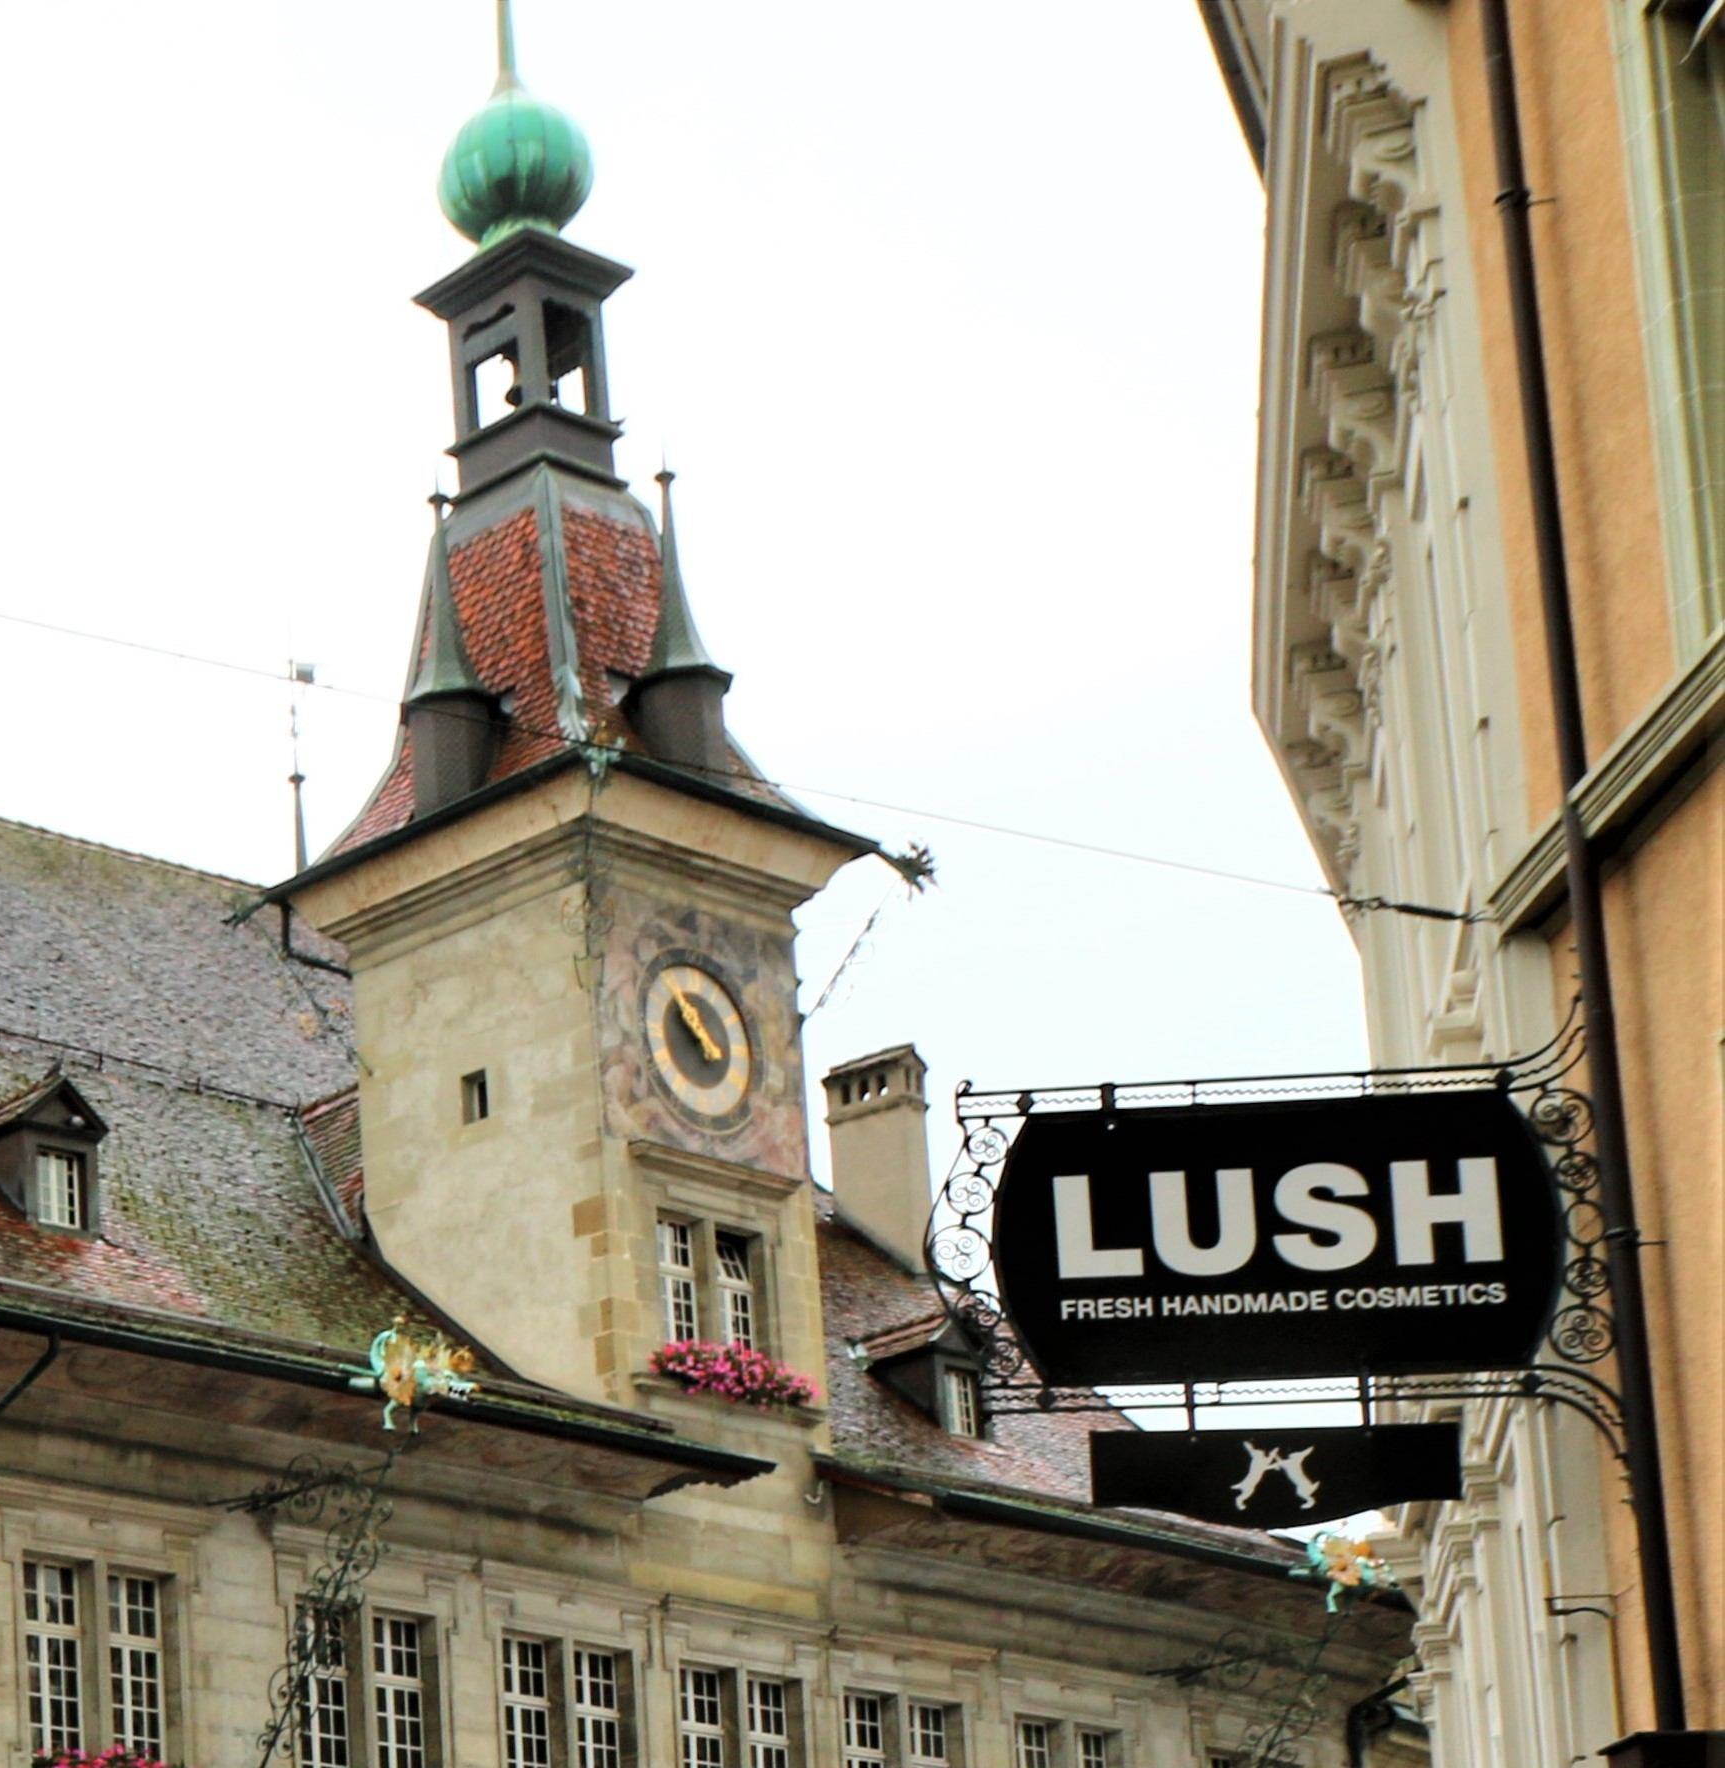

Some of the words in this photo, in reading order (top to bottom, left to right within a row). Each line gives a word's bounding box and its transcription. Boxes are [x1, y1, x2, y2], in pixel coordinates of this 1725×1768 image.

[1053, 1156, 1504, 1279] LUSH
[1060, 1297, 1153, 1321] FRESH
[1162, 1289, 1329, 1317] HANDMADE
[1334, 1282, 1507, 1311] COSMETICS
